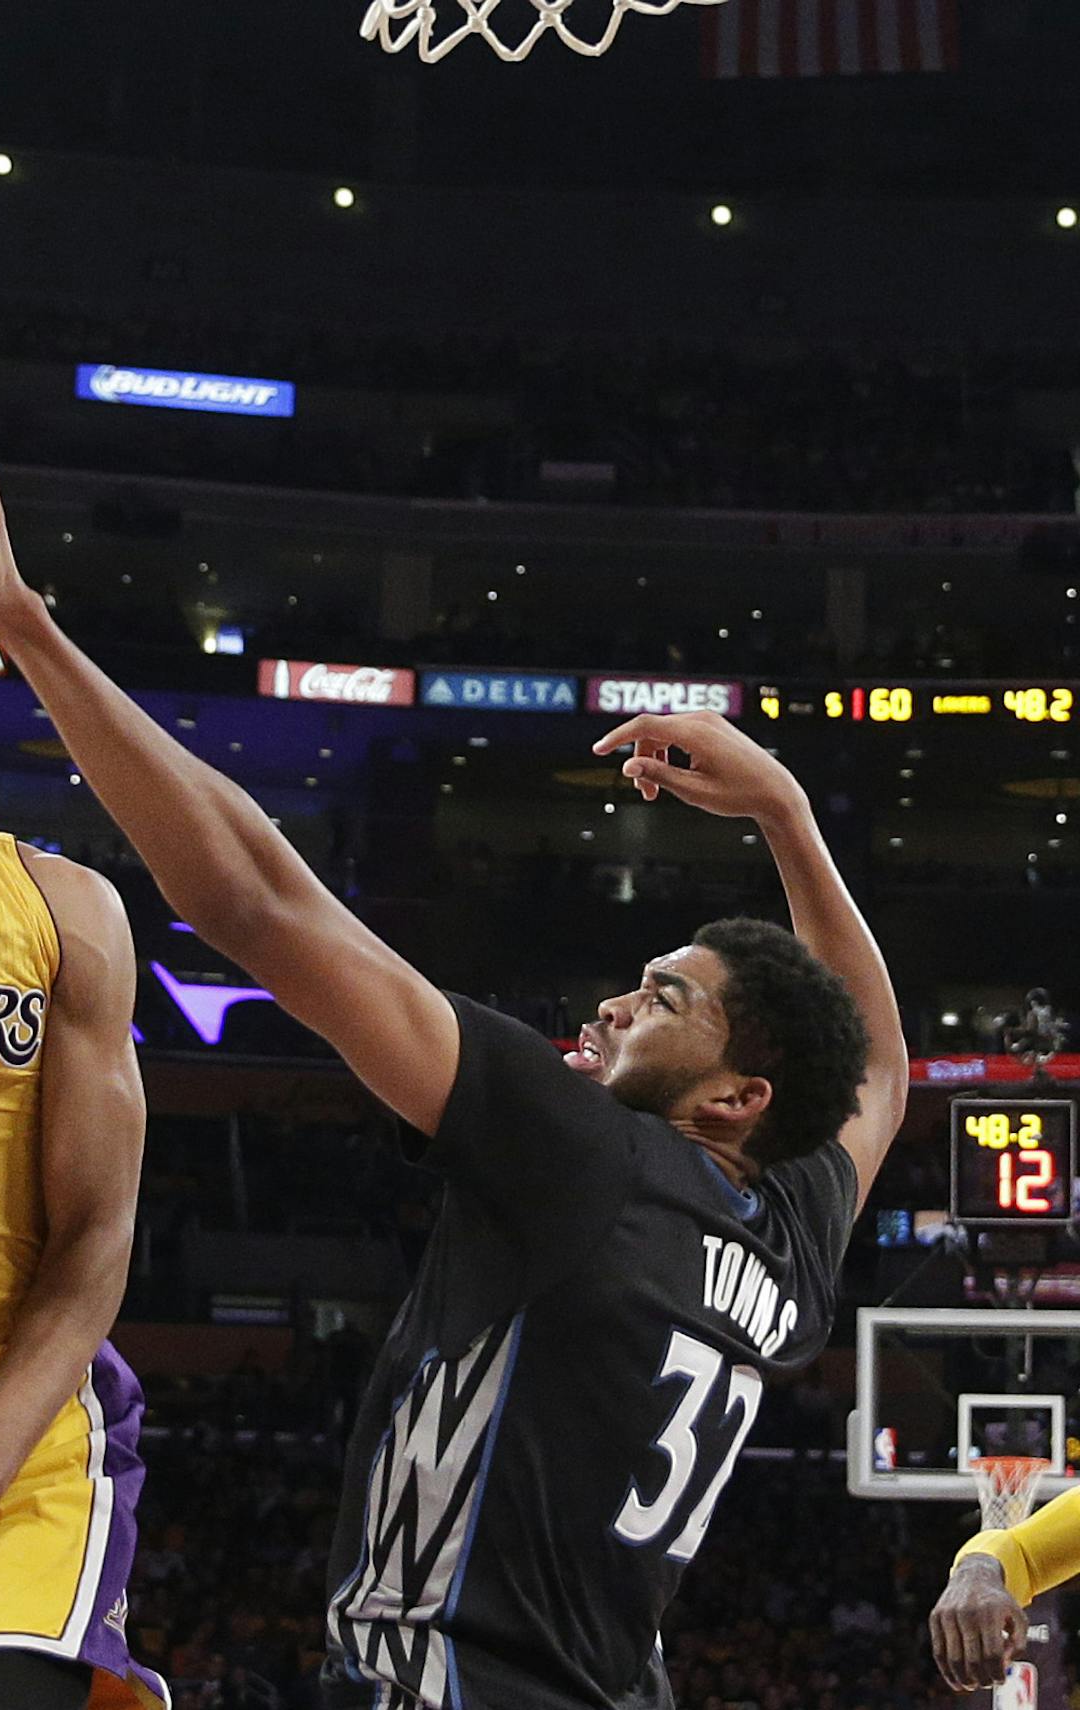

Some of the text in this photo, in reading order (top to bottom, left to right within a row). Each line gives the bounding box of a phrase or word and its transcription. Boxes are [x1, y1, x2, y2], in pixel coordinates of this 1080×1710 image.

[180, 377, 278, 406] LIGHT
[462, 678, 575, 705] DELTA
[598, 679, 730, 714] STAPLES
[869, 687, 913, 722] 60
[965, 1113, 1043, 1150] 48.2
[998, 1149, 1054, 1212] 12
[702, 1234, 798, 1358] TOWNS
[610, 1328, 764, 1564] 32
